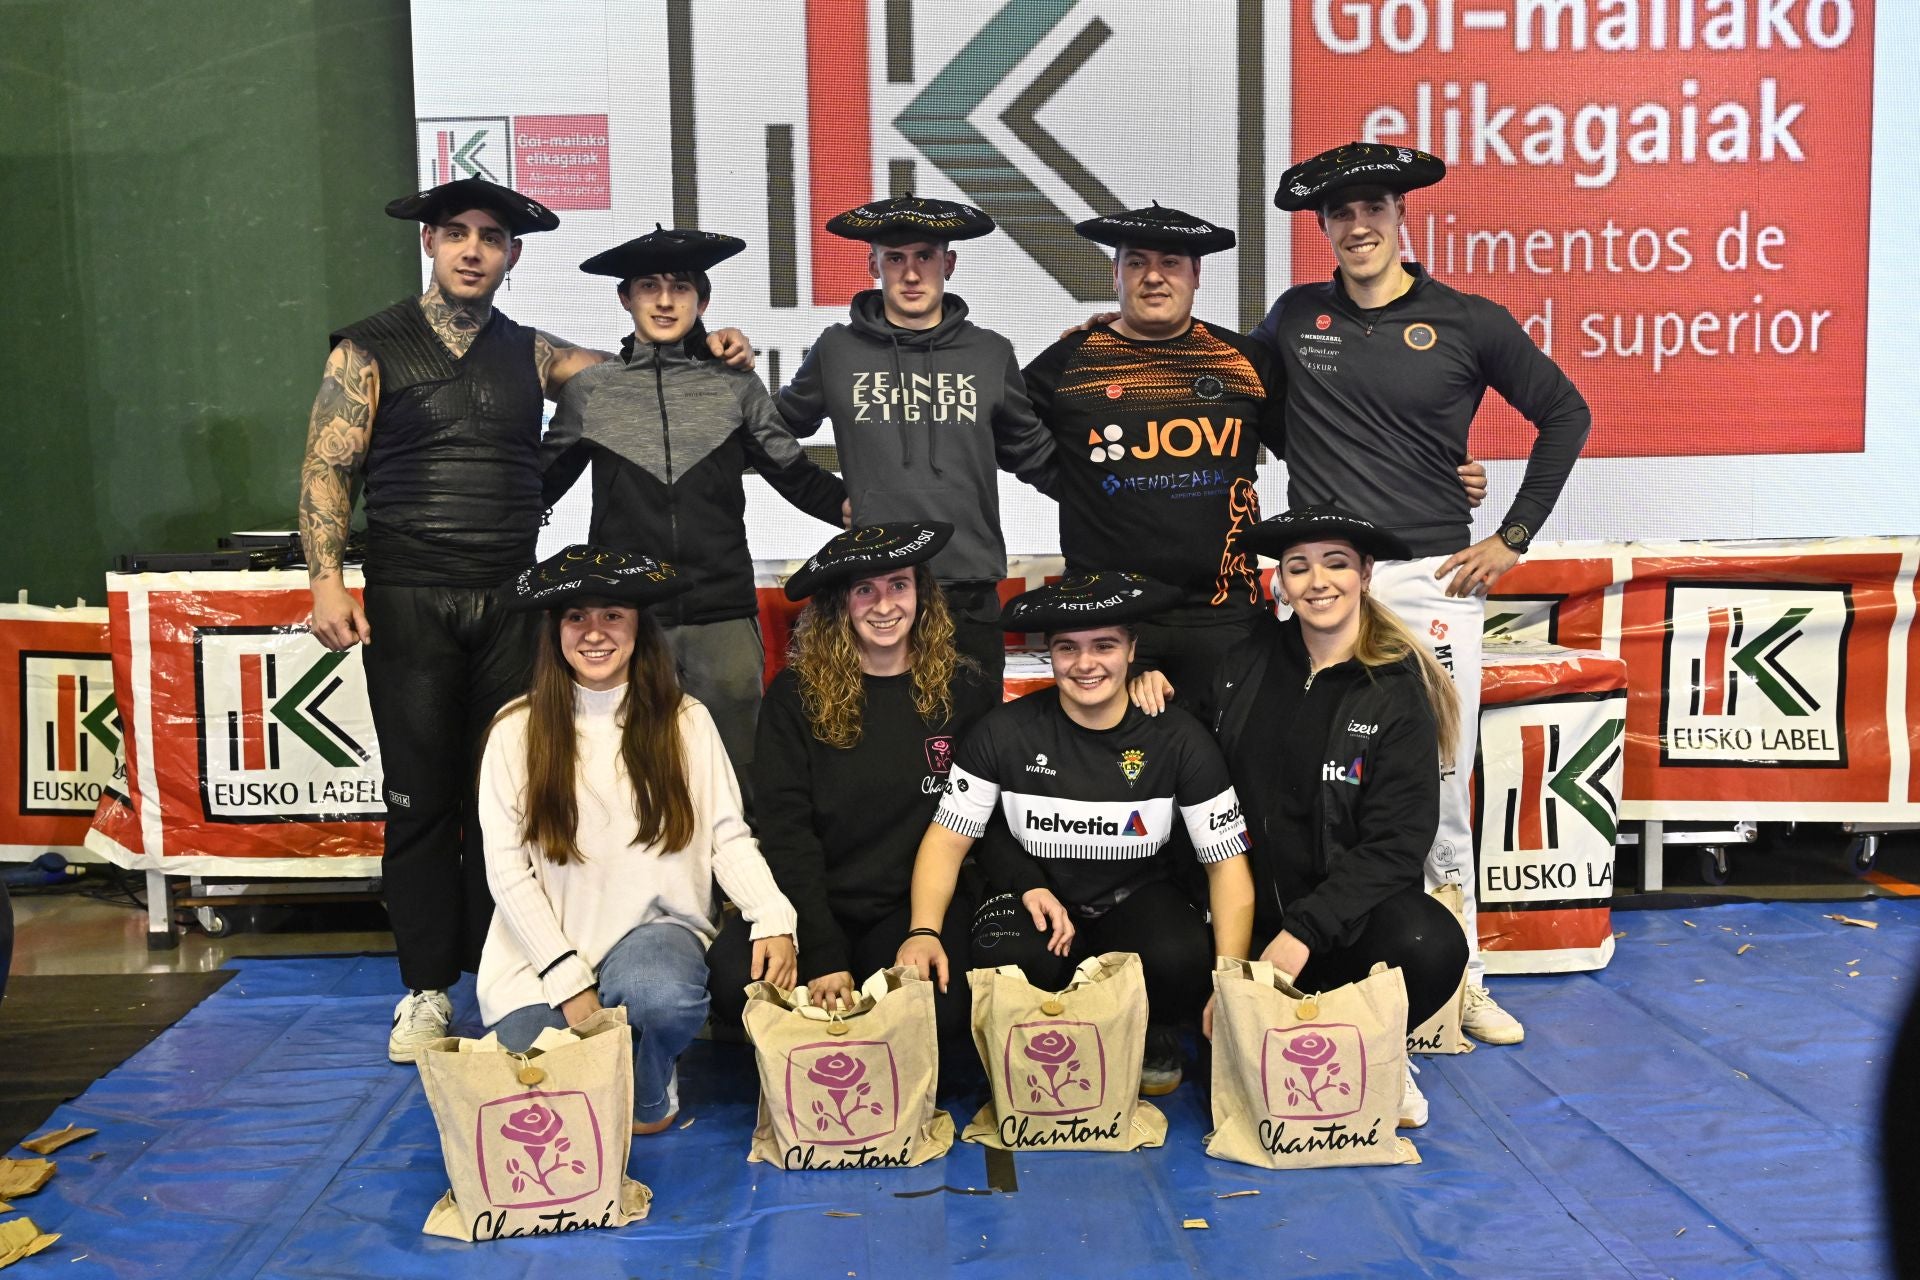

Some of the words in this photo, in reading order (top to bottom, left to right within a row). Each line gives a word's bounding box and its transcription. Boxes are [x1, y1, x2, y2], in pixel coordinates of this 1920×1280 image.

[1362, 78, 1804, 188] elikagaiak
[526, 151, 599, 168] elikagaiak
[1399, 211, 1692, 274] Alimentos
[1715, 210, 1786, 272] de
[1581, 301, 1832, 372] superior
[853, 387, 977, 406] ESANGO
[853, 403, 977, 423] ZIGUN
[1131, 416, 1243, 460] JOVI
[888, 529, 936, 560] ASTEASU
[1057, 594, 1124, 612] ASTEASU
[1673, 727, 1752, 751] EUSKO
[1761, 728, 1835, 751] LABEL
[1025, 764, 1057, 777] VIATOR
[33, 780, 103, 803] EUSKO
[214, 782, 299, 806] EUSKO
[308, 780, 384, 804] LABEL
[1026, 809, 1119, 836] helvetia
[1486, 862, 1577, 891] EUSKO
[1000, 1111, 1122, 1149] Chantoné
[1258, 1117, 1381, 1155] Chantoné
[785, 1136, 912, 1171] Chantoné
